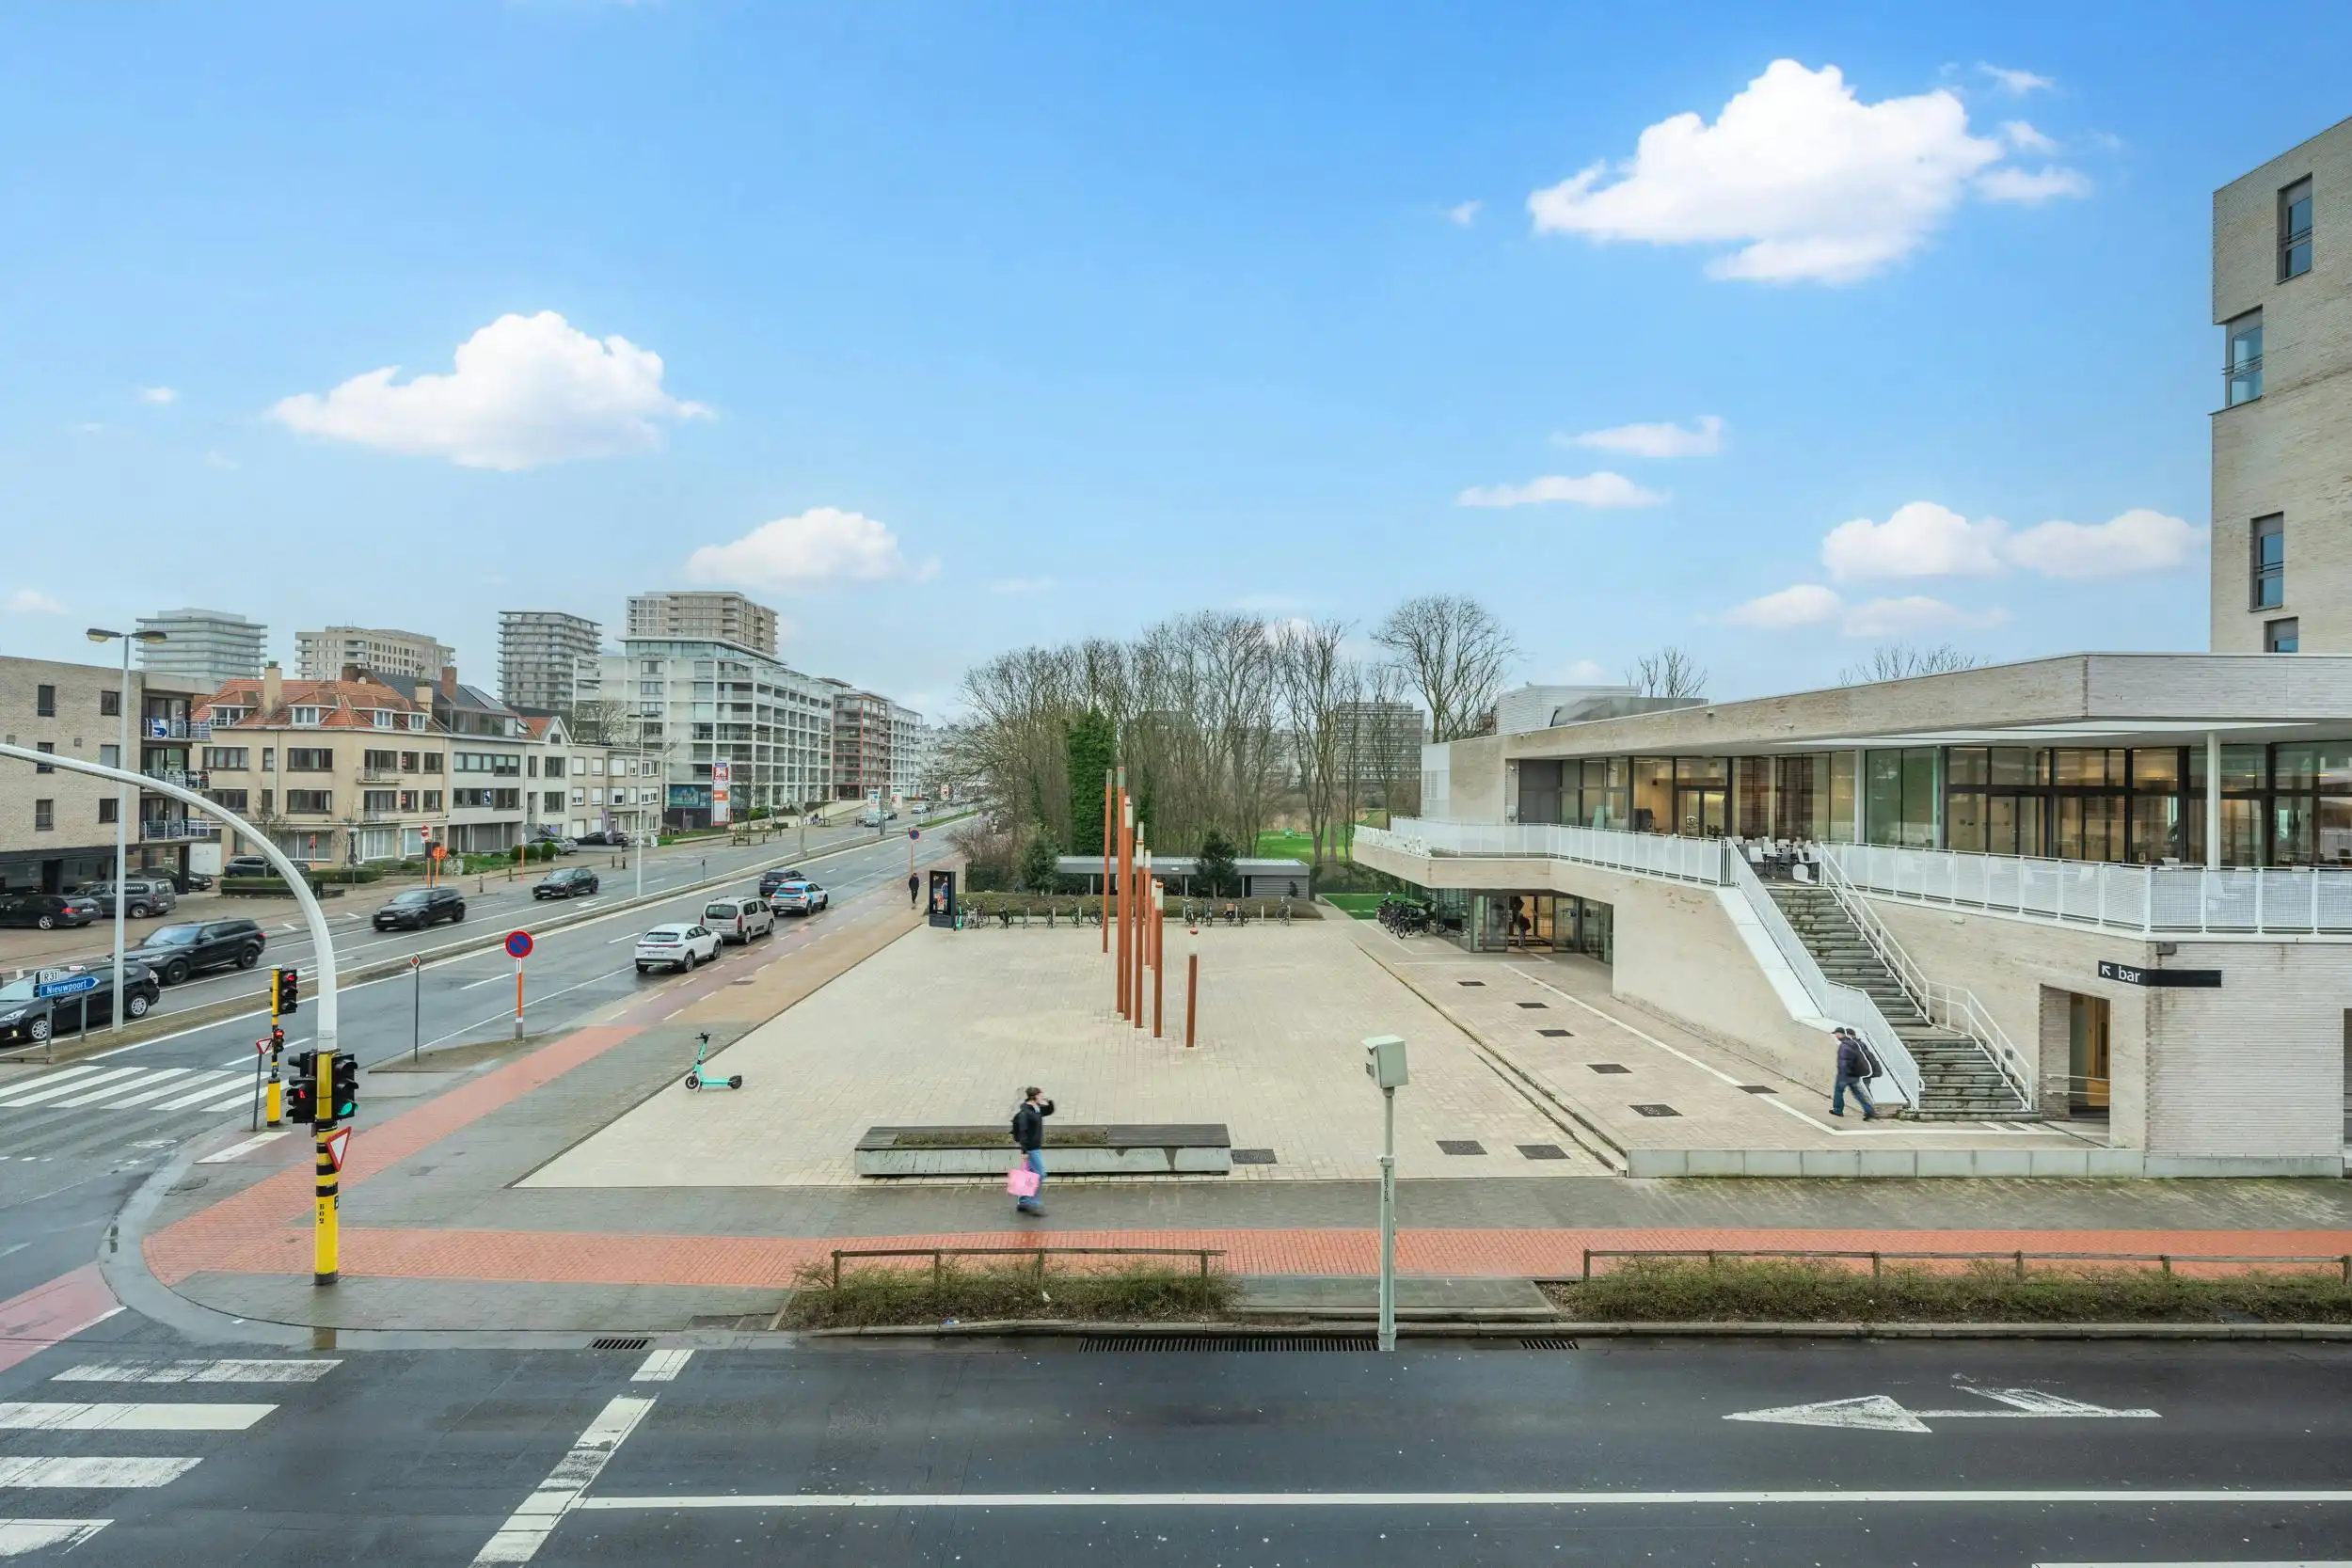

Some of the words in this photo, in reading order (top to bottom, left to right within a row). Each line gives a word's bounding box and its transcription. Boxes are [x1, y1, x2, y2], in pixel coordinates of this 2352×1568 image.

[43, 972, 57, 981] R31
[2118, 965, 2140, 983] bar
[47, 979, 87, 993] Nieuwpoort
